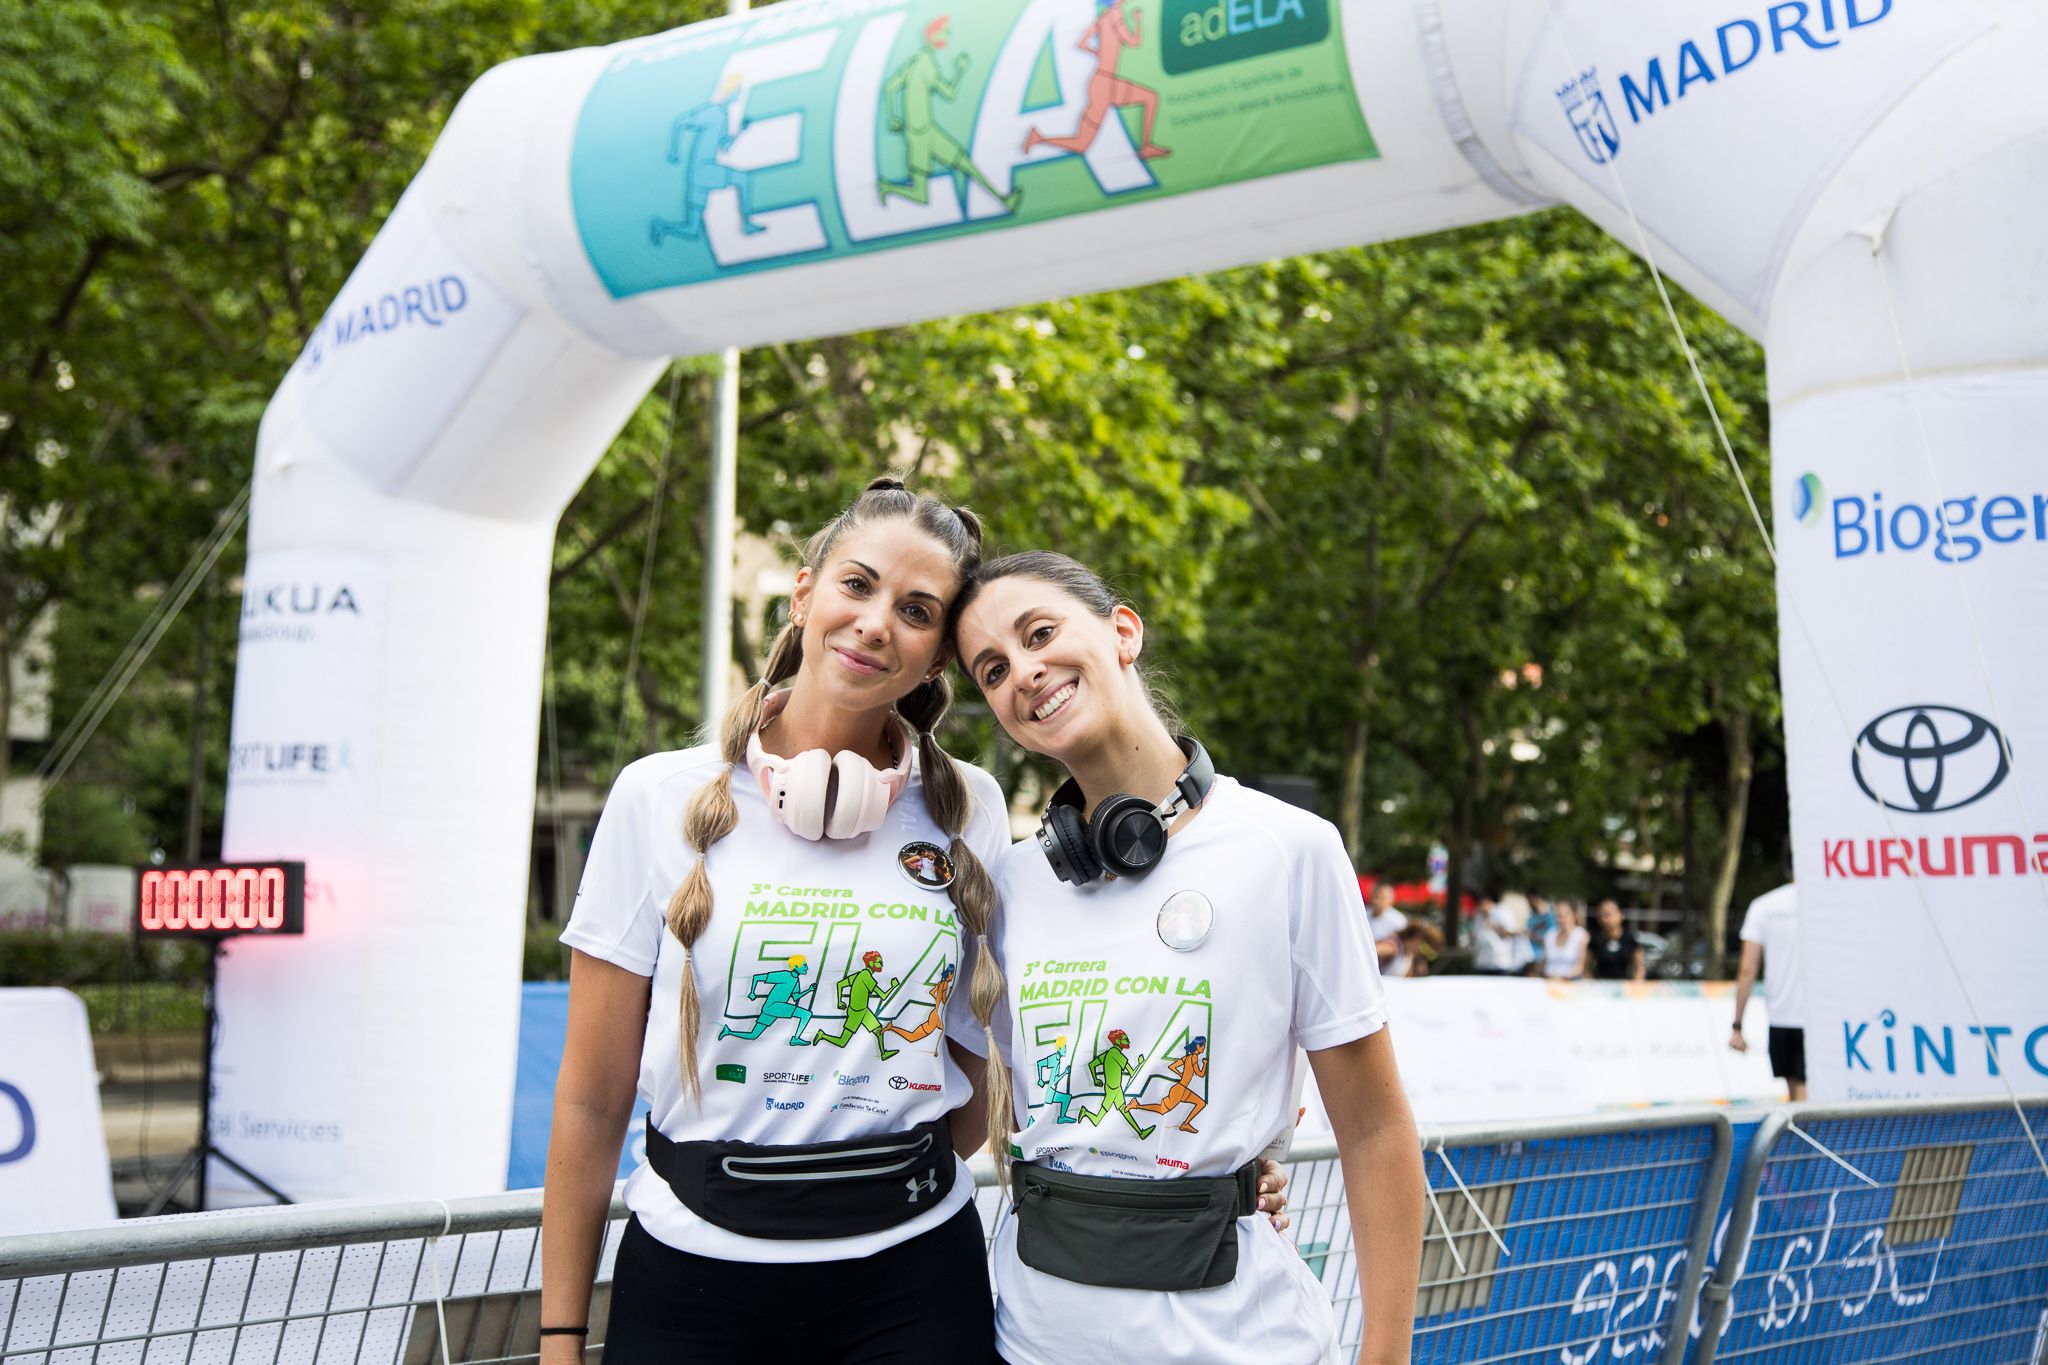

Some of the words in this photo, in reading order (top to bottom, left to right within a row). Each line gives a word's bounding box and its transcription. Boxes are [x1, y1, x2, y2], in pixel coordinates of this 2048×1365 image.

[1180, 0, 1305, 47] adELA
[1619, 0, 1893, 125] MADRID
[776, 885, 853, 898] Carrera
[744, 901, 860, 919] MADRID
[867, 903, 927, 921] CON
[934, 908, 958, 930] LA
[1043, 959, 1108, 974] Carrera
[1019, 977, 1109, 1003] MADRID
[1114, 975, 1169, 995] CON
[1175, 977, 1212, 999] LA
[838, 1074, 870, 1086] Biogen
[773, 1101, 805, 1111] MADRID
